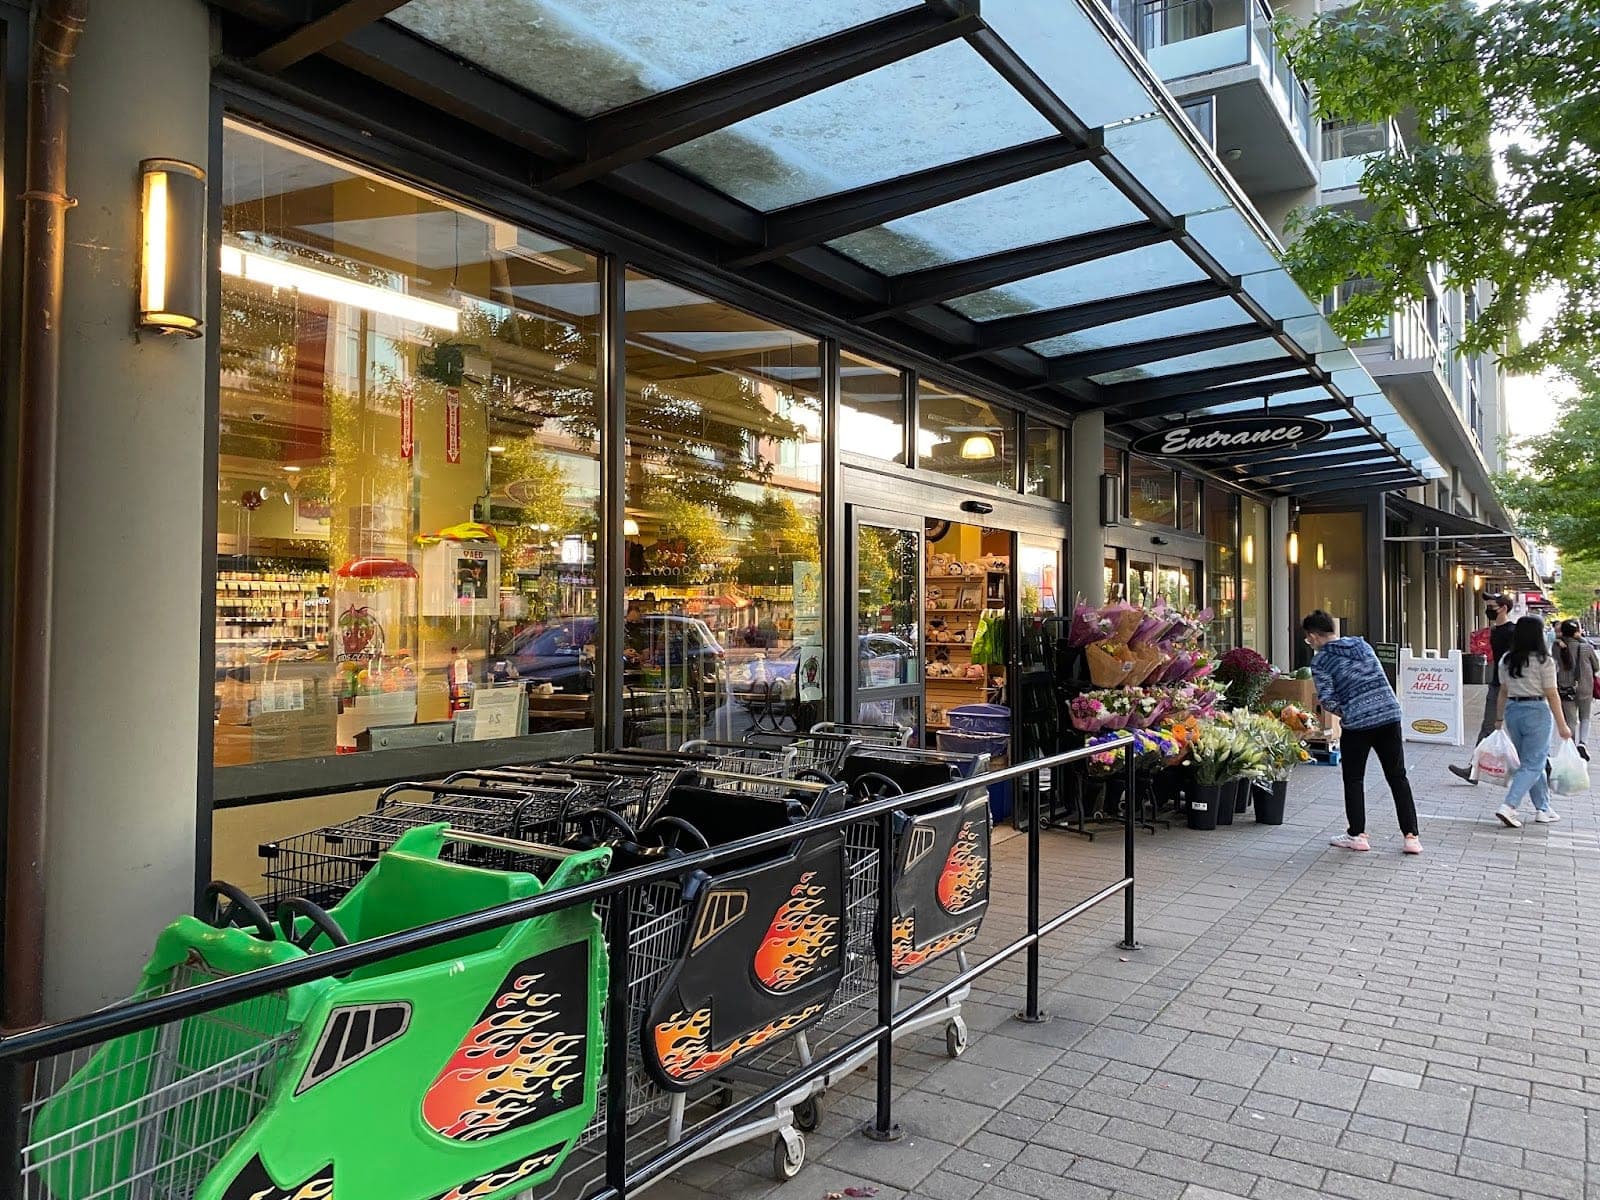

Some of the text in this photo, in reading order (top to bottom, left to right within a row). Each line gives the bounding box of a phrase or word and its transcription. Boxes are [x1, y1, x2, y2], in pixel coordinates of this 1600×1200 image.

[1161, 425, 1304, 454] Entrance
[470, 551, 484, 559] AED
[1417, 673, 1443, 682] CALL
[1410, 682, 1450, 691] AHEAD
